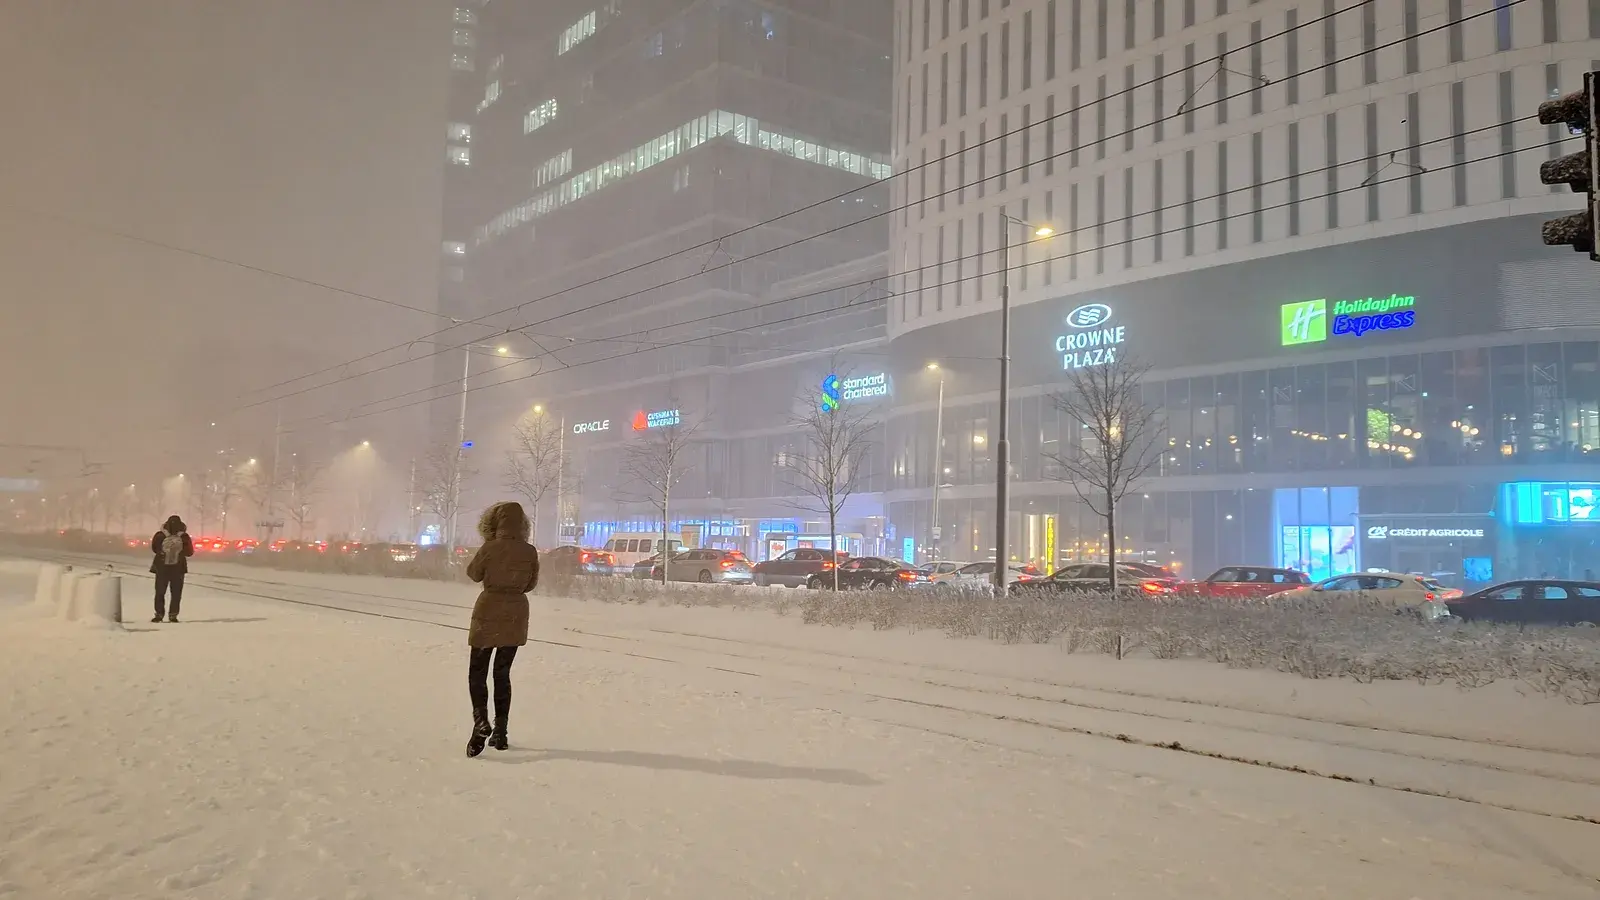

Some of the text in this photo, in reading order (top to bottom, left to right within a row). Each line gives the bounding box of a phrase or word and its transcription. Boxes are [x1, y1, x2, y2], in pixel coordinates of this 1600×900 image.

[1333, 310, 1415, 337] Express
[1056, 326, 1125, 352] CROWNE
[1064, 347, 1116, 369] PLAZA
[843, 372, 884, 389] standard
[844, 384, 886, 399] chartered
[647, 410, 674, 420] CUSHMAN
[647, 417, 680, 428] WAKEFIELD
[573, 419, 610, 434] ORACLE
[1389, 527, 1429, 537] CRÉDIT
[1428, 528, 1484, 537] AGRICOLE
